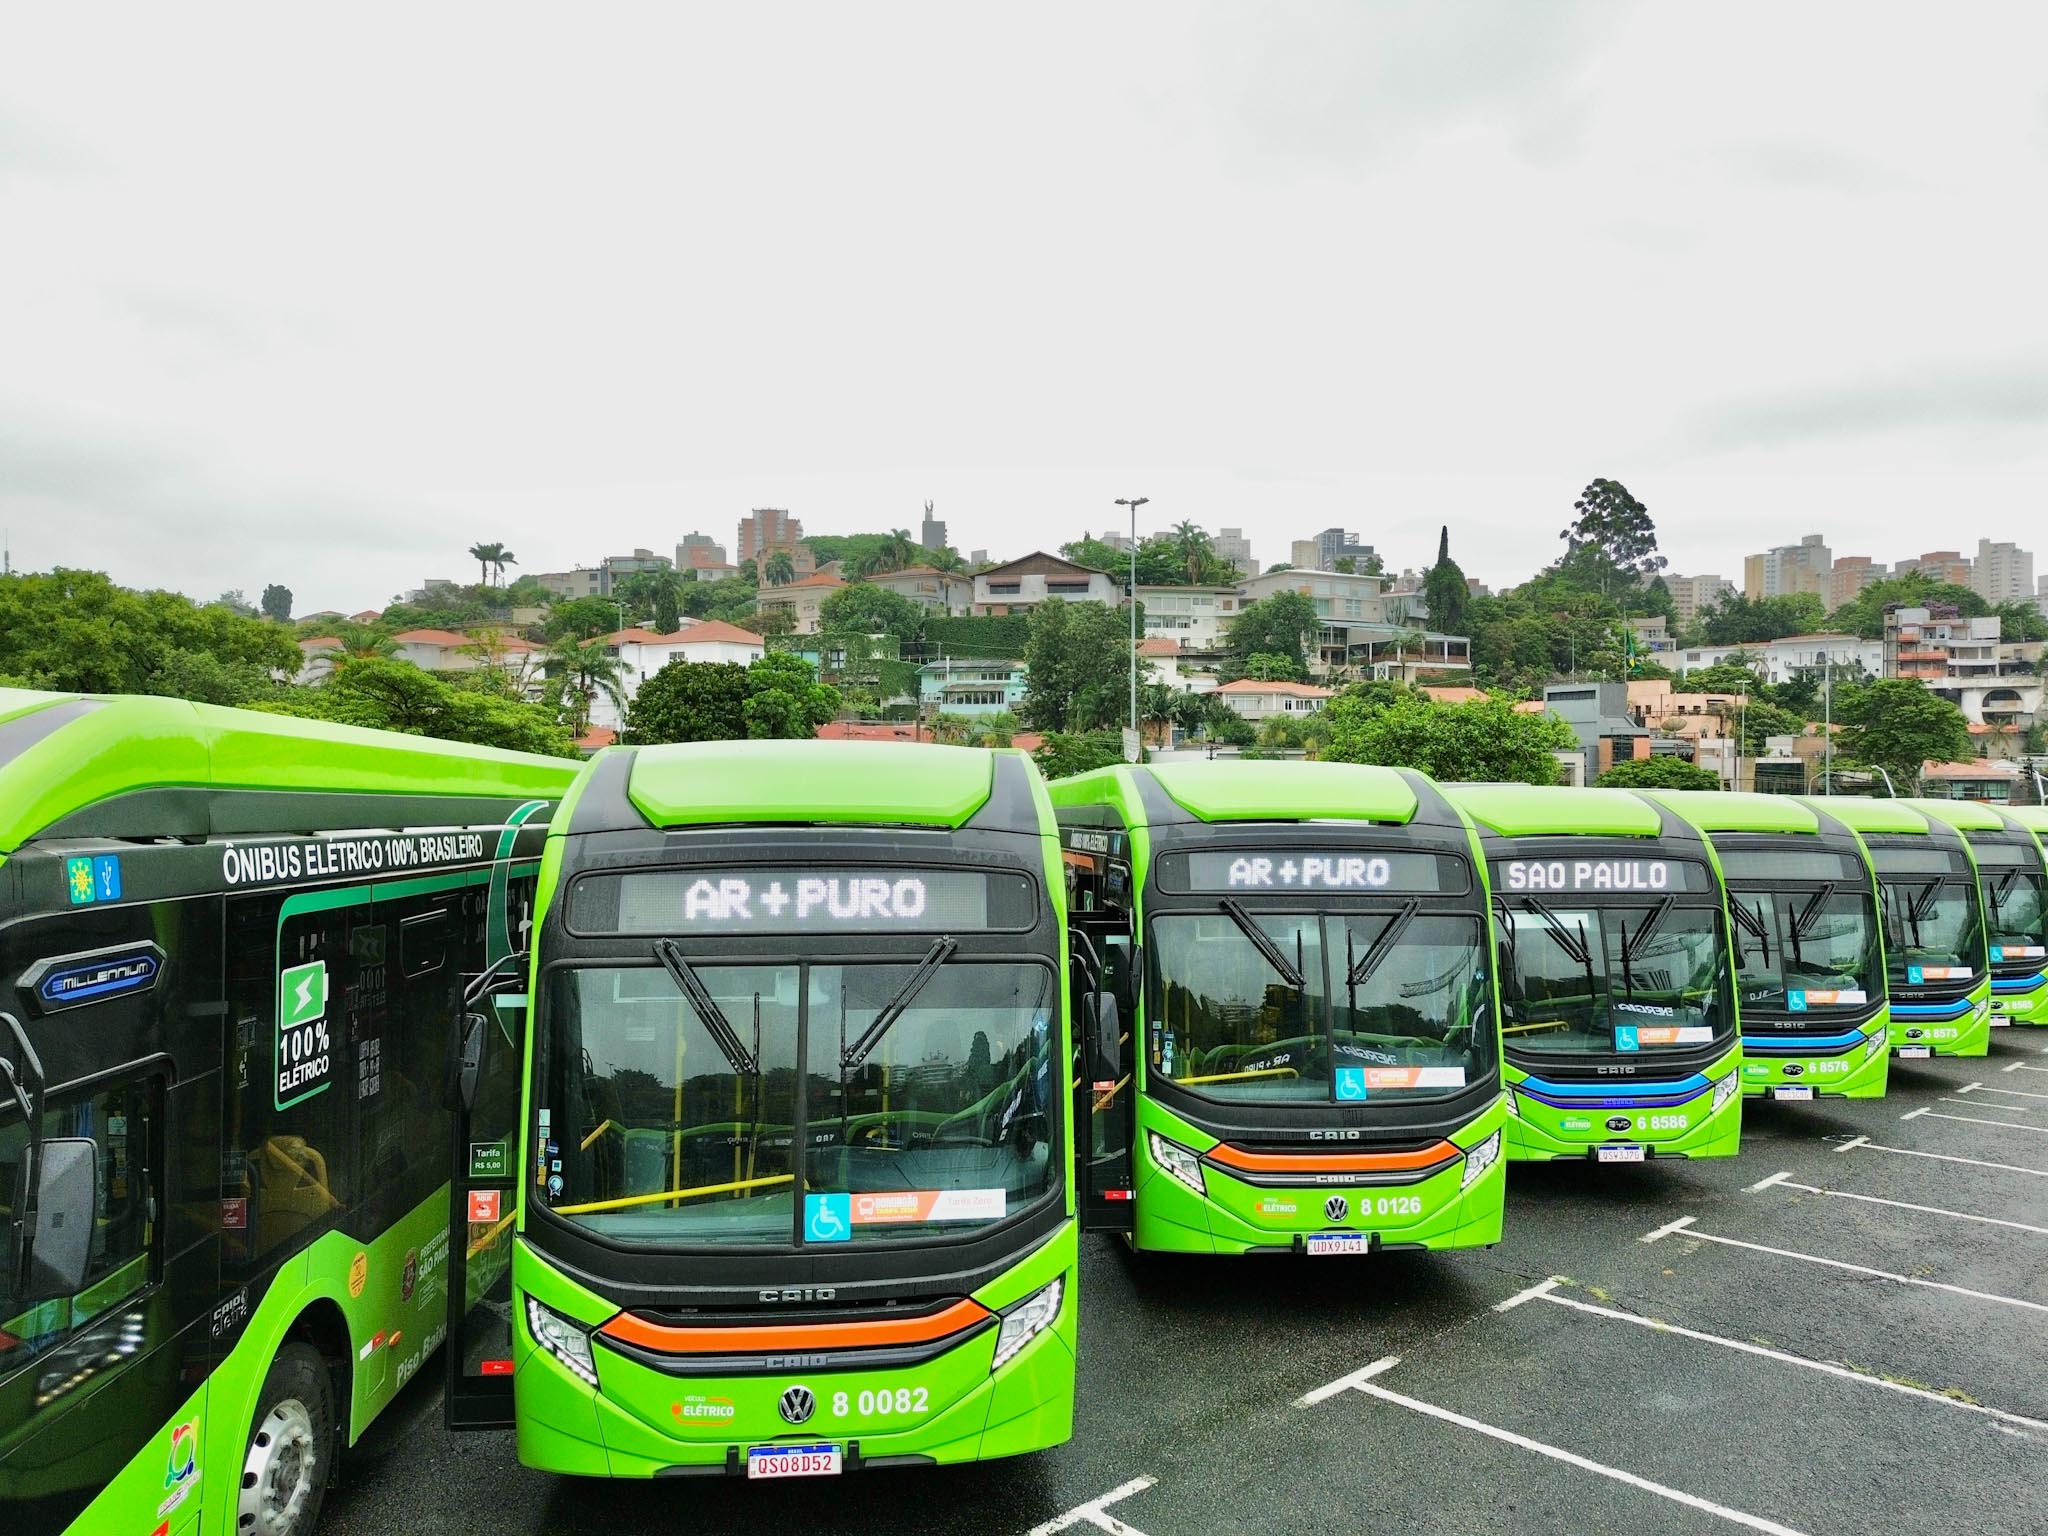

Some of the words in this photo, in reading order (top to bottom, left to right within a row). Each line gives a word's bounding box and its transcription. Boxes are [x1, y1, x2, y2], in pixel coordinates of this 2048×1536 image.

[223, 841, 302, 884] ÔNIBUS
[305, 838, 384, 876] ELÉTRICO
[385, 838, 418, 866] 100%
[420, 834, 483, 864] BRASILEIRO
[1229, 857, 1273, 885] AR
[1279, 859, 1298, 884] +
[1302, 857, 1390, 886] PURO
[1509, 862, 1566, 889] SAO
[1574, 862, 1667, 889] PAULO
[685, 878, 752, 920] AR
[760, 881, 790, 917] +
[796, 878, 925, 918] PURO
[1924, 1029, 1931, 1038] 6
[1933, 1028, 1957, 1038] 8573
[280, 1020, 330, 1066] 100%
[279, 1054, 330, 1093] ELÉTRICO
[1809, 1062, 1817, 1073] 6
[1820, 1061, 1849, 1073] 8576
[1637, 1116, 1646, 1130] 6
[1651, 1115, 1687, 1129] 8586
[1309, 1131, 1360, 1140] CAIO
[476, 1149, 500, 1157] Tarifa
[487, 1161, 501, 1169] 5,00
[1264, 1204, 1297, 1212] ELÉTRICO
[1361, 1199, 1372, 1215] 8
[1378, 1197, 1421, 1214] 0126
[759, 1289, 836, 1302] CAIO
[766, 1356, 827, 1368] CAIO
[396, 1355, 419, 1388] Piso
[832, 1391, 849, 1416] 8
[858, 1387, 929, 1415] 0082
[683, 1402, 734, 1417] ELÉTRICO
